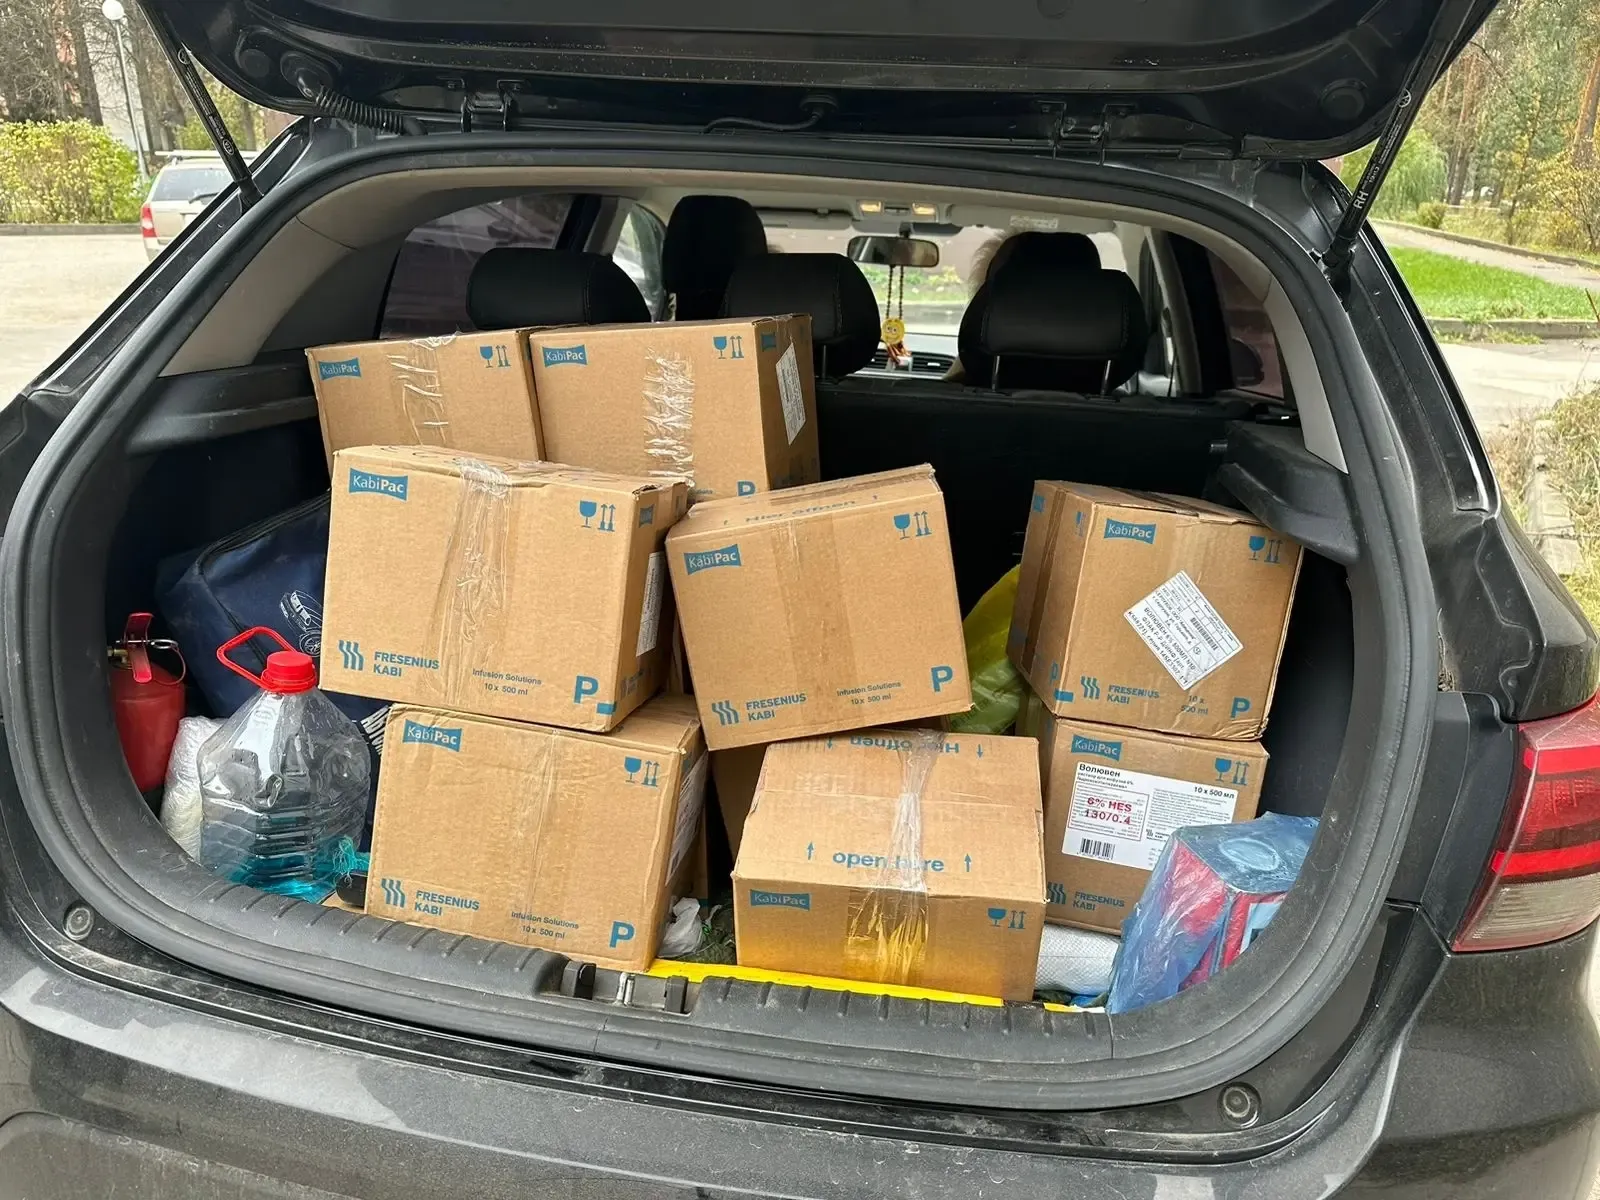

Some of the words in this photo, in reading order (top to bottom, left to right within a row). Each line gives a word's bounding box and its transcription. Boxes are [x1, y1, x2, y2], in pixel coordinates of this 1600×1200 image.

[1353, 191, 1369, 209] RH
[544, 350, 585, 362] KabiPac
[320, 363, 359, 376] KabiPac
[353, 475, 404, 493] KabiPac
[1107, 522, 1152, 538] KabiPac
[688, 551, 737, 568] KabiPac
[1143, 606, 1167, 635] ВОЛЮВЕН
[374, 651, 440, 670] FRESENIUS
[373, 664, 402, 677] KABI
[472, 668, 503, 681] Infusion
[505, 672, 542, 685] Solutions
[931, 666, 953, 692] P
[484, 682, 493, 691] 10
[502, 685, 516, 694] 500
[517, 687, 528, 696] ml
[573, 675, 599, 704] P
[837, 687, 866, 698] Infusion
[867, 680, 902, 693] Solutions
[1108, 684, 1160, 699] FRESENIUS
[746, 693, 807, 711] FRESENIUS
[867, 695, 881, 704] 500
[882, 693, 892, 702] ml
[1107, 693, 1130, 705] KABI
[1188, 695, 1198, 703] 10
[747, 710, 775, 722] KABI
[1180, 705, 1196, 714] 500
[1197, 707, 1208, 715] ml
[1230, 697, 1251, 719] P
[407, 724, 457, 745] KabiPac
[1074, 740, 1118, 756] KabiPac
[1078, 763, 1121, 777] Волювен
[1208, 789, 1222, 797] 500
[1086, 796, 1105, 808] 6%
[1107, 800, 1132, 813] HES
[1083, 808, 1131, 824] 130/0.4
[832, 852, 889, 868] open
[415, 890, 480, 911] FRESENIUS
[754, 892, 807, 907] KabiPac
[1072, 900, 1096, 911] KABI
[1074, 891, 1125, 907] FRESENIUS
[414, 902, 443, 916] KABI
[511, 911, 542, 924] Infusion
[543, 915, 580, 929] Solutions
[522, 924, 531, 934] 10
[539, 927, 553, 937] 500
[555, 930, 565, 939] ml
[609, 921, 636, 949] P
